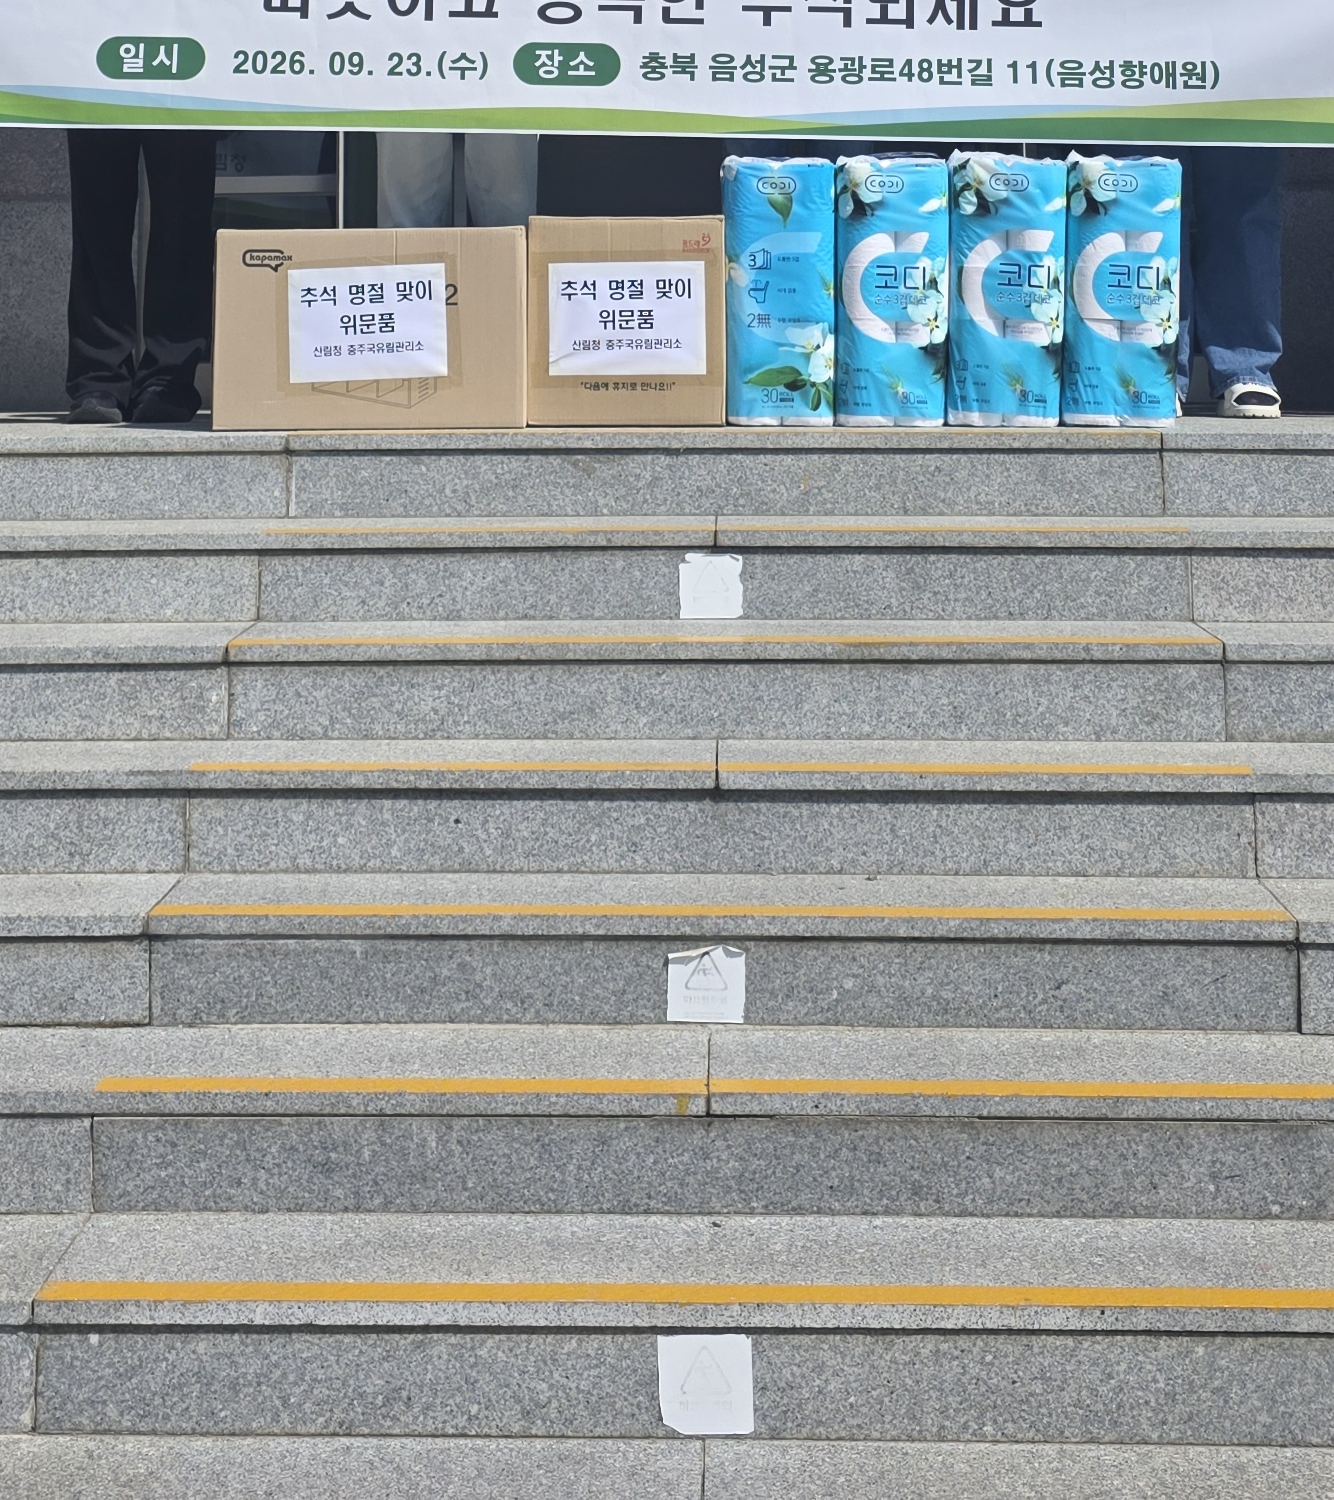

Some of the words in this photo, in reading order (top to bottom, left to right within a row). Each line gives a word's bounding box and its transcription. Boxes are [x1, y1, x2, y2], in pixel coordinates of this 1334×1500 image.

[118, 42, 181, 75] 일시
[232, 50, 315, 76] 2026.
[328, 51, 374, 76] 09.
[386, 50, 490, 82] 23.(수)
[534, 49, 597, 79] 장소
[639, 52, 699, 82] 충북
[708, 53, 798, 84] 음성군
[807, 55, 994, 87] 용광로48번길
[1006, 58, 1220, 91] 11(음성향애원)
[249, 253, 293, 264] kapamax
[875, 265, 926, 290] 코디
[998, 262, 1051, 289] 코디
[1107, 263, 1160, 290] 코디
[300, 286, 337, 308] 추석
[348, 282, 385, 306] 명절
[396, 279, 433, 303] 맞이
[560, 280, 597, 302] 추석
[608, 278, 644, 301] 명절
[655, 278, 692, 300] 맞이
[339, 312, 396, 336] 위문품
[598, 309, 655, 331] 위문품
[313, 345, 342, 358] 산림청
[347, 341, 425, 356] 충주국유림관리소
[572, 339, 601, 352] 산림청
[605, 338, 682, 351] 충주국유림관리소
[612, 381, 638, 392] 휴지로
[760, 388, 779, 404] 30
